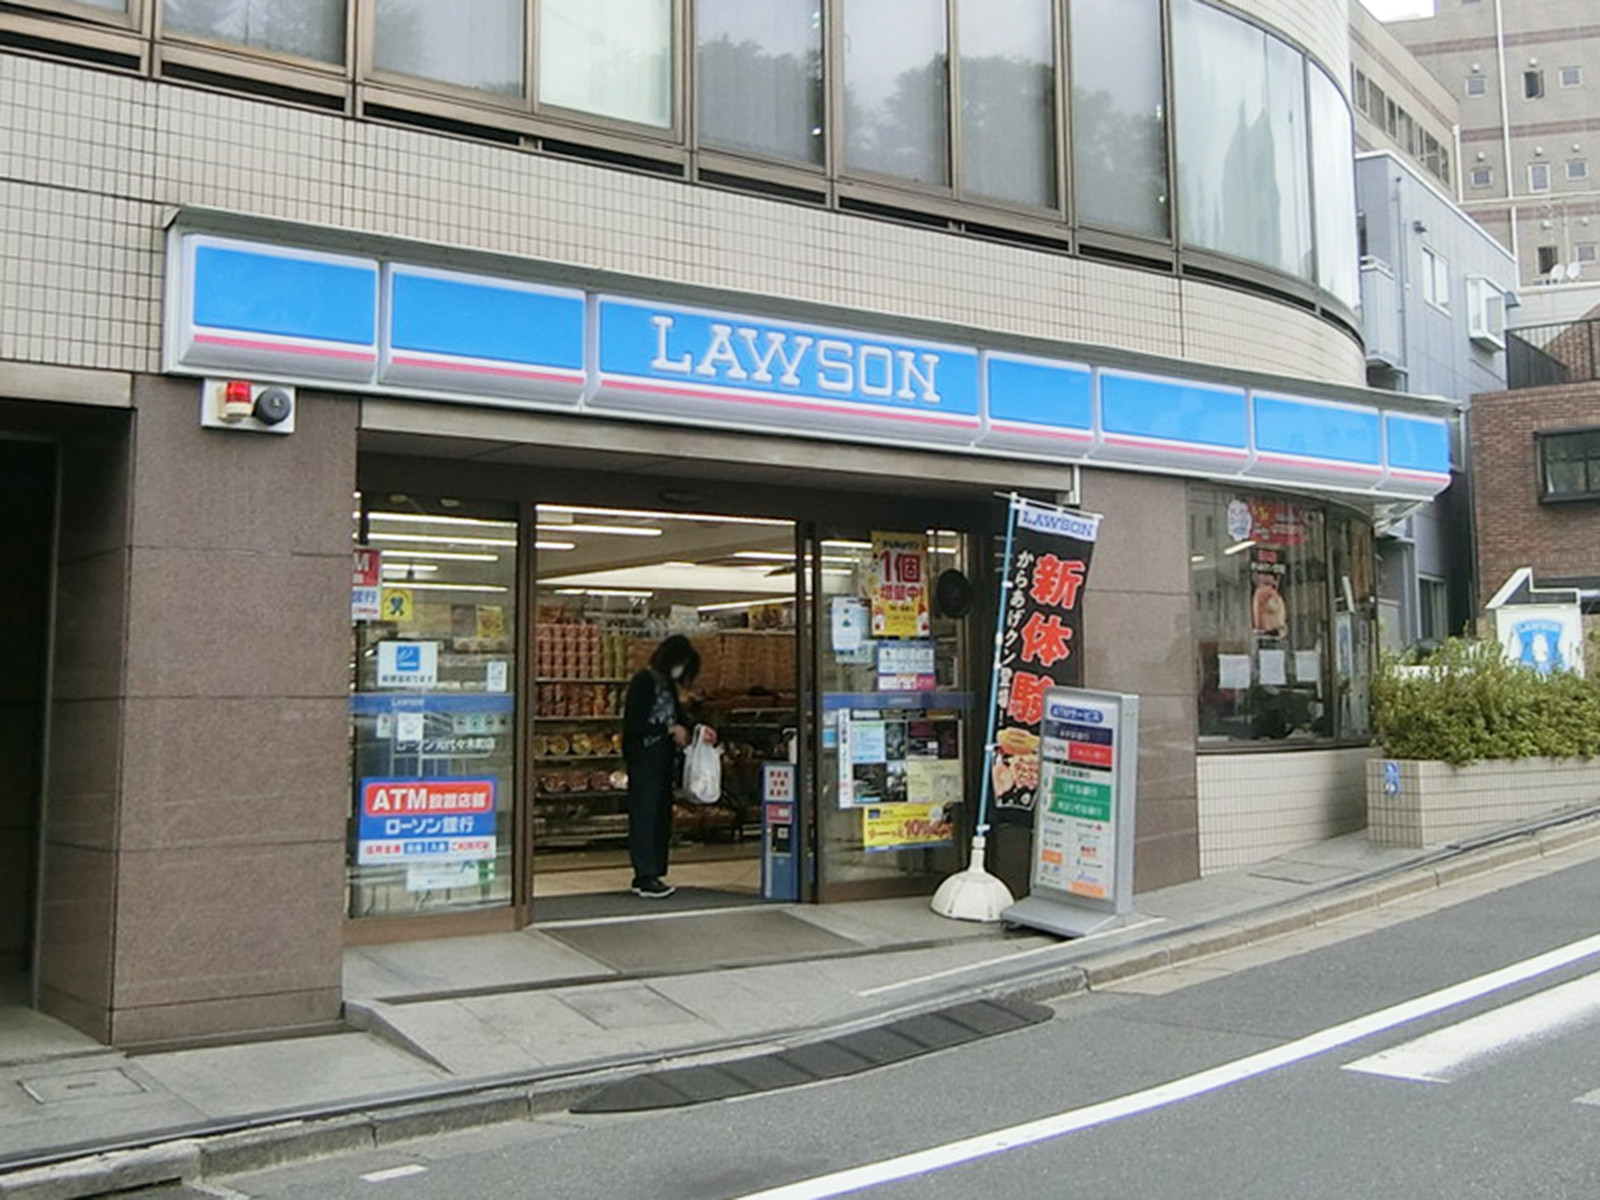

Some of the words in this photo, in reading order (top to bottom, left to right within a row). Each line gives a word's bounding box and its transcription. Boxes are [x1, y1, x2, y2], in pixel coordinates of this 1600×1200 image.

[651, 315, 942, 404] LAWSON
[1022, 510, 1094, 536] LAWSON
[879, 550, 921, 583] 1個
[385, 816, 475, 835] ローソン銀行
